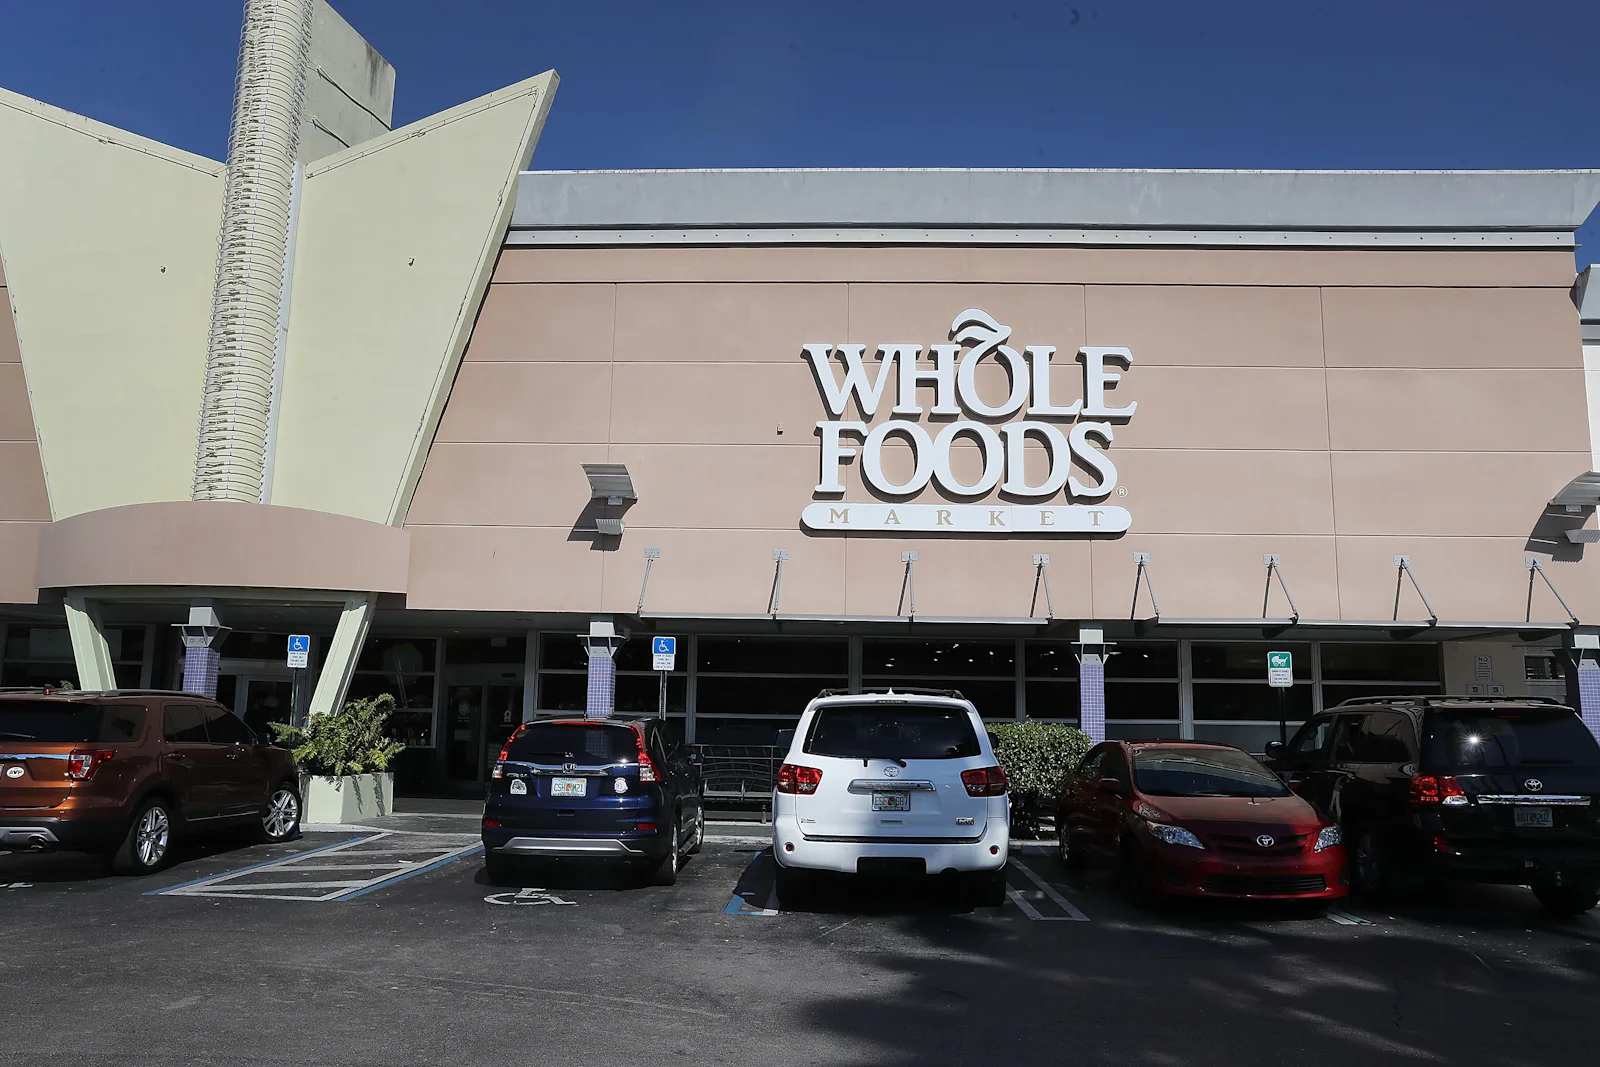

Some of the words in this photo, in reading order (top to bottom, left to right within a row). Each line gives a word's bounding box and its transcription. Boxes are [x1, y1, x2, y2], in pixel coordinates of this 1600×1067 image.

[802, 308, 1138, 417] WHOLE
[815, 419, 1118, 497] FOODS
[828, 507, 1105, 527] MARKET
